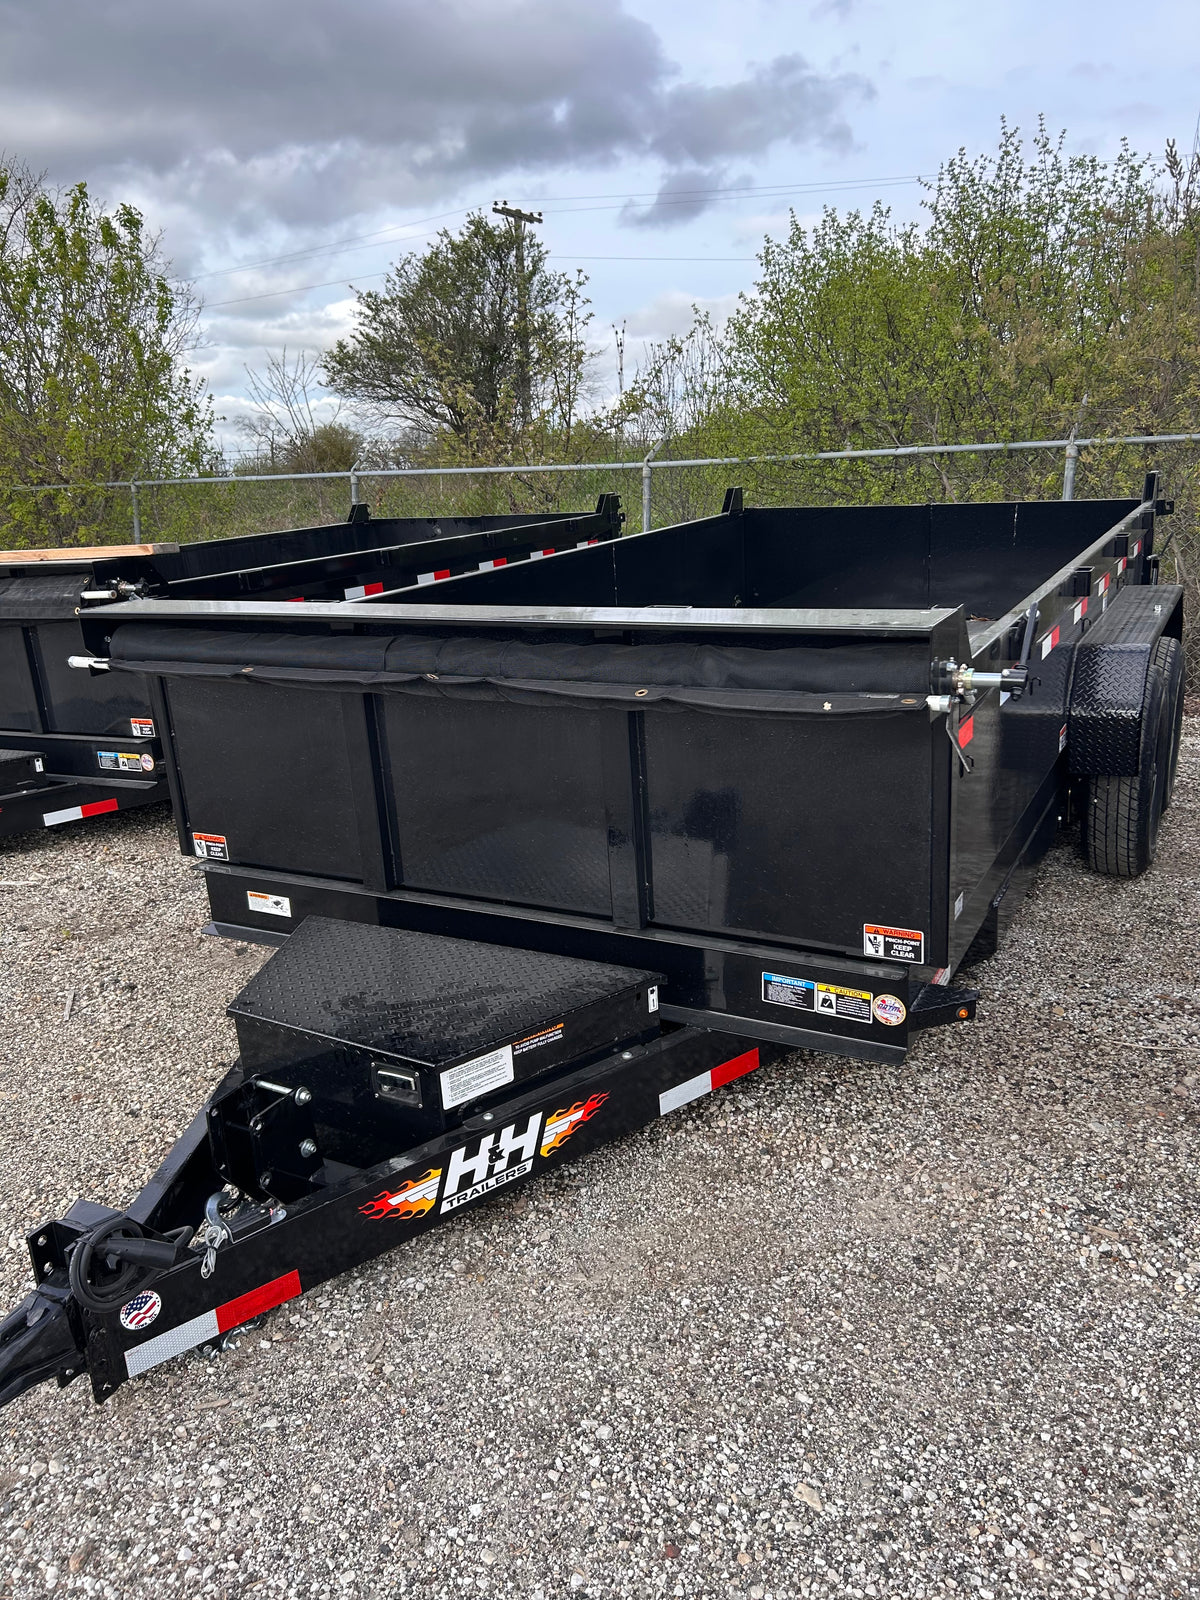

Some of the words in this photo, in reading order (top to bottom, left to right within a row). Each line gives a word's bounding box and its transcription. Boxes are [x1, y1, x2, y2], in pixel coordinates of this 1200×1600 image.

[883, 928, 915, 938] WARNING
[885, 937, 921, 946] PINCH-POINT
[893, 943, 913, 952] KEEP
[890, 950, 915, 959] CLEAR
[771, 975, 806, 987] IMPORTANT
[834, 988, 863, 998] CAUTION
[443, 1111, 543, 1198] H&H
[446, 1163, 528, 1208] TRAILERS
